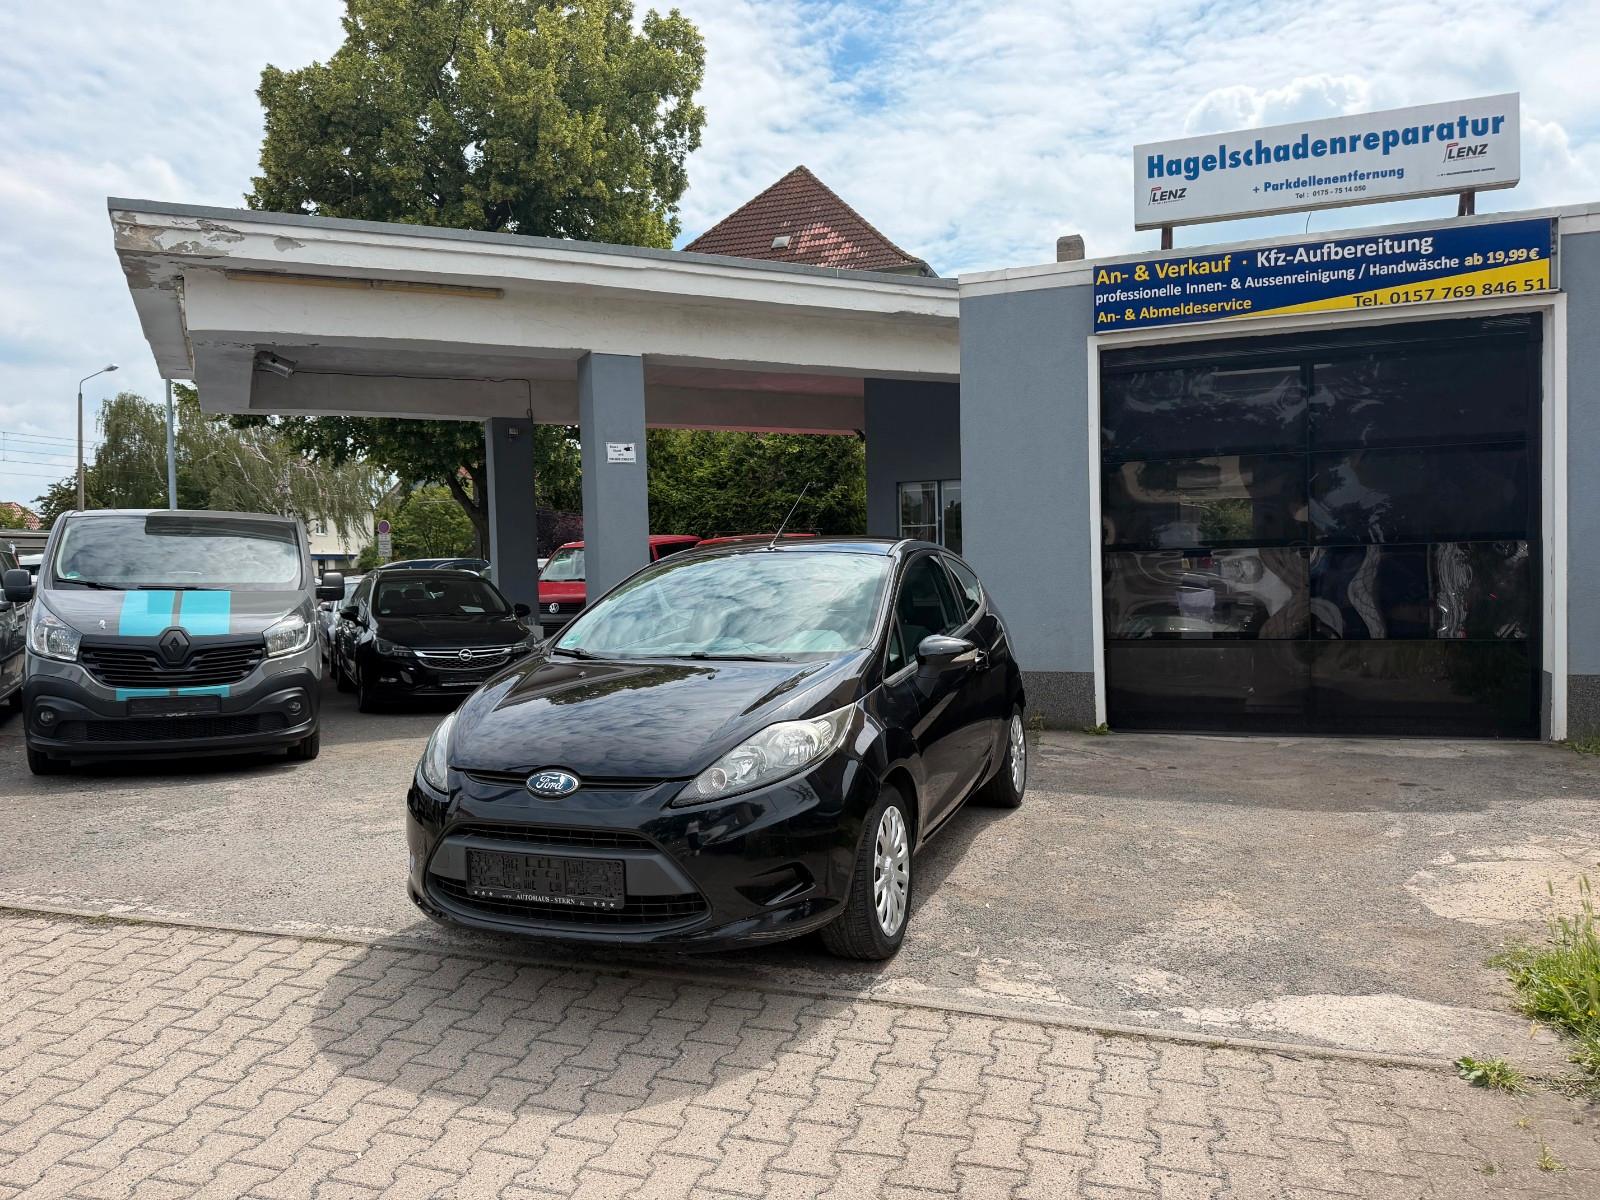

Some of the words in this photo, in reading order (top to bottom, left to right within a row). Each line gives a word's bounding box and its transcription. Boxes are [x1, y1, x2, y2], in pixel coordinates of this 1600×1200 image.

[1147, 114, 1505, 181] Hagelschadenreparatur
[1447, 143, 1488, 160] LENZ
[1263, 167, 1405, 193] Parkdellenentfernung
[1312, 188, 1329, 197] 0175
[1151, 187, 1187, 203] LENZ
[1096, 269, 1129, 286] An-
[1134, 264, 1149, 282] &
[1155, 254, 1231, 279] Verkauf
[1257, 236, 1433, 268] Kfz-Aufbereitung
[1095, 283, 1182, 306] professionelle
[1186, 282, 1226, 295] Innen-
[1231, 277, 1241, 290] &
[1244, 268, 1355, 289] Aussenreinigung
[1358, 263, 1366, 279] /
[1369, 255, 1459, 276] Handwäsche
[1464, 252, 1483, 267] ab
[1353, 293, 1383, 308] Tel.
[1389, 288, 1435, 305] 0157
[1441, 284, 1475, 300] 769
[1482, 280, 1517, 296] 846
[1524, 277, 1546, 291] 51
[1097, 311, 1120, 324] An-
[1124, 308, 1136, 321] &
[1139, 299, 1252, 320] Abmeldeservice
[535, 774, 566, 790] Ford
